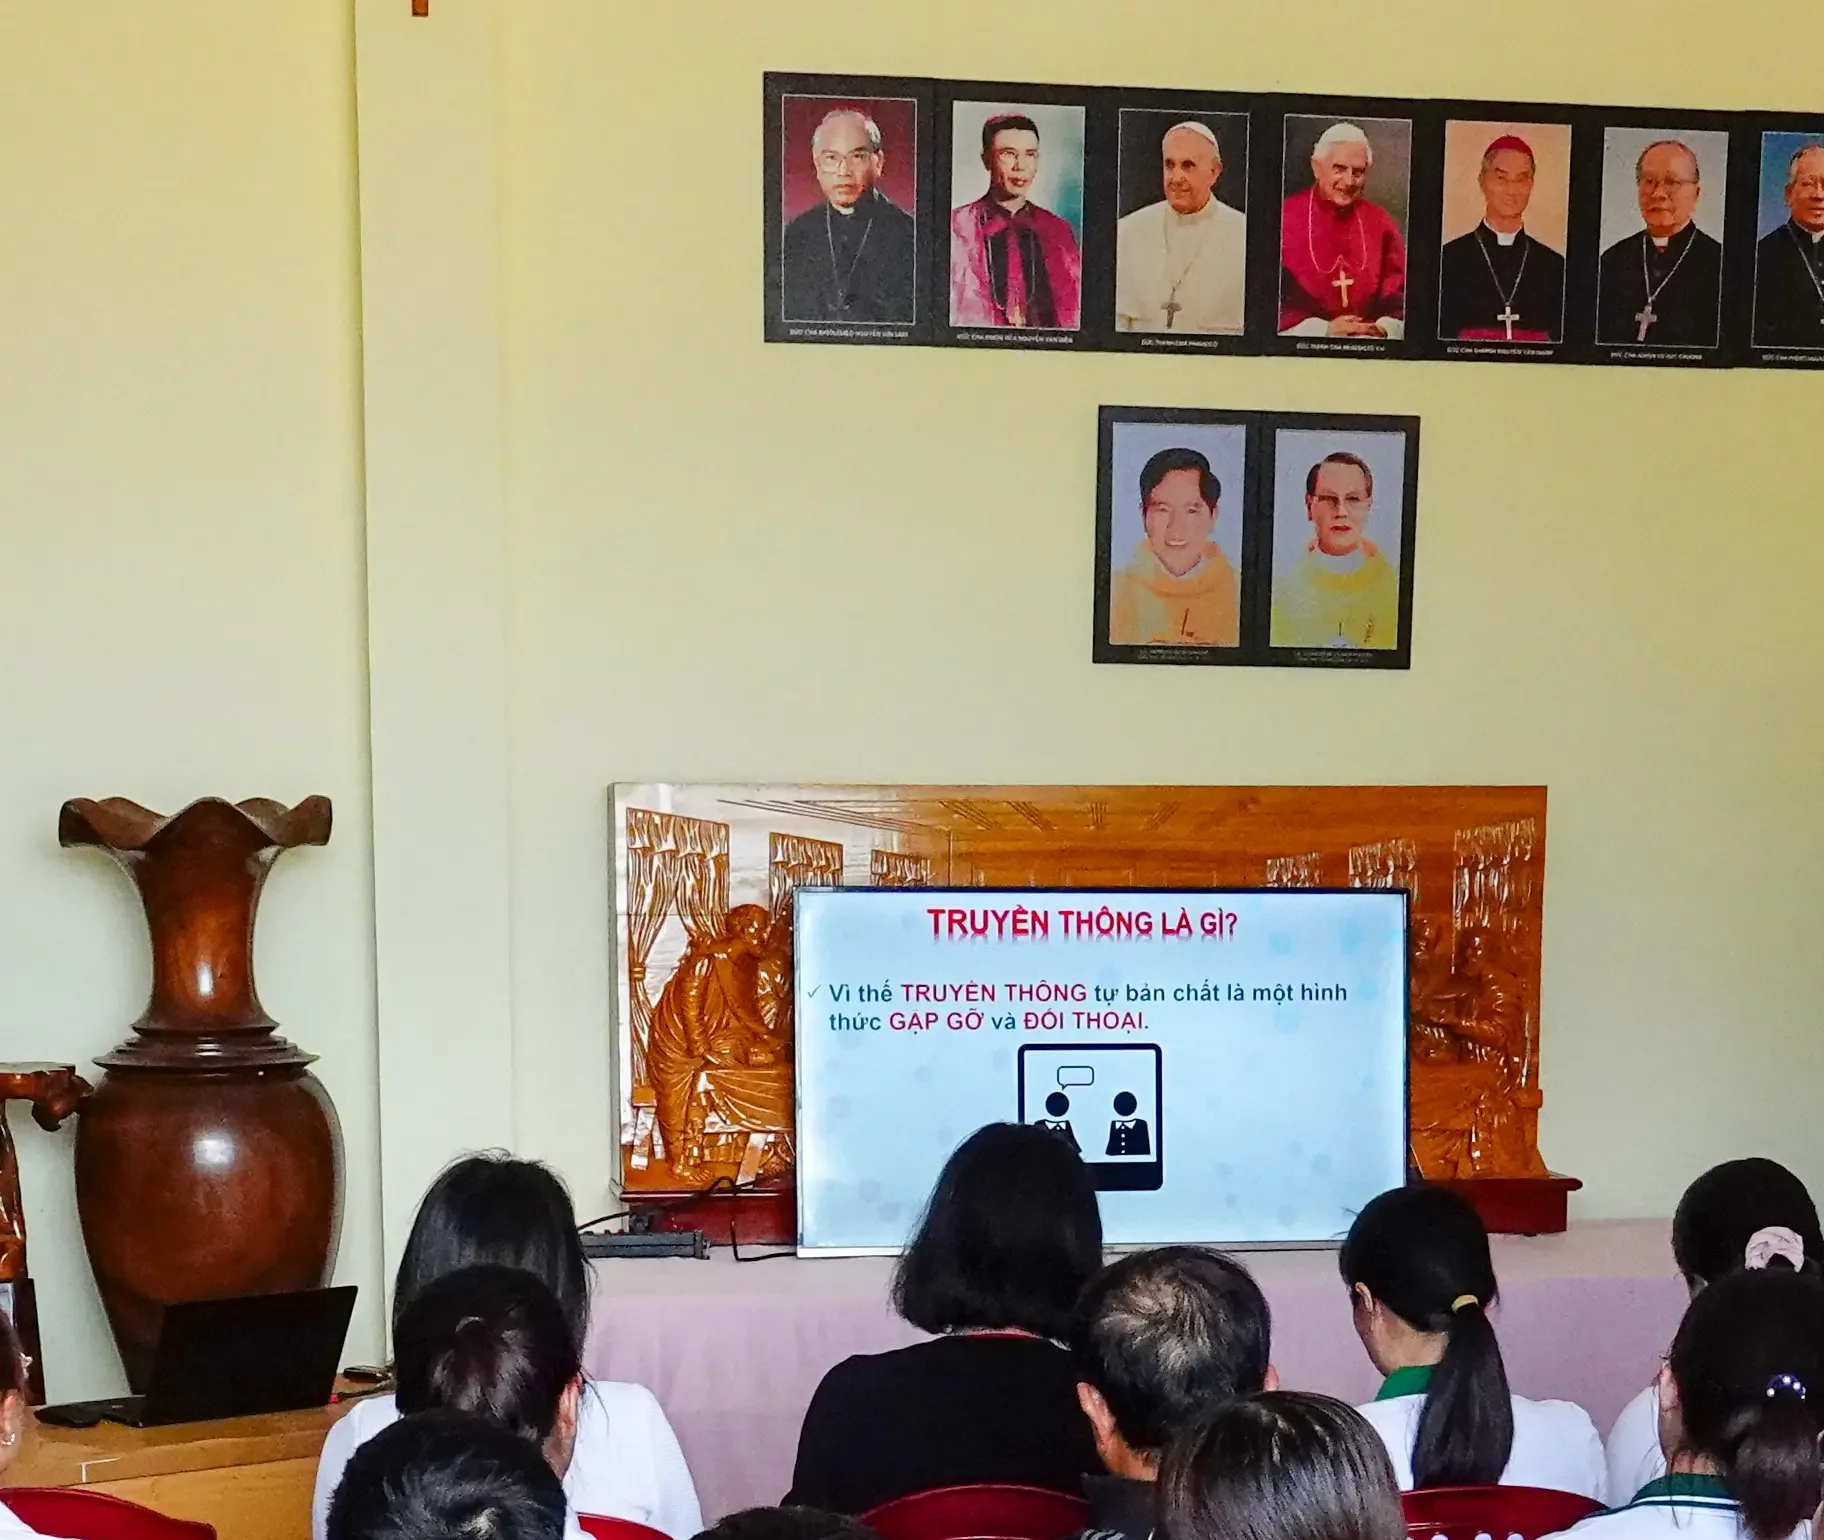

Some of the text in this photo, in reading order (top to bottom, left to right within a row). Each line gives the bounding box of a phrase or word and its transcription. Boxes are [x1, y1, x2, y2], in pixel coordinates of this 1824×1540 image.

[926, 904, 1238, 936] TRUYỀN THÔNG LÀ GÌ?
[829, 983, 850, 1002] Vì
[858, 979, 893, 1002] thế
[1004, 979, 1087, 1002] THÔNG
[1094, 984, 1119, 1006] tự
[1126, 983, 1165, 1002] bản
[1173, 978, 1220, 1002] chất
[1227, 983, 1245, 1001] là
[1252, 983, 1294, 1006] một
[1301, 982, 1347, 1001] hình
[829, 1012, 881, 1031] thức
[992, 1011, 1016, 1030] và
[1071, 1012, 1149, 1034] THOẠI.
